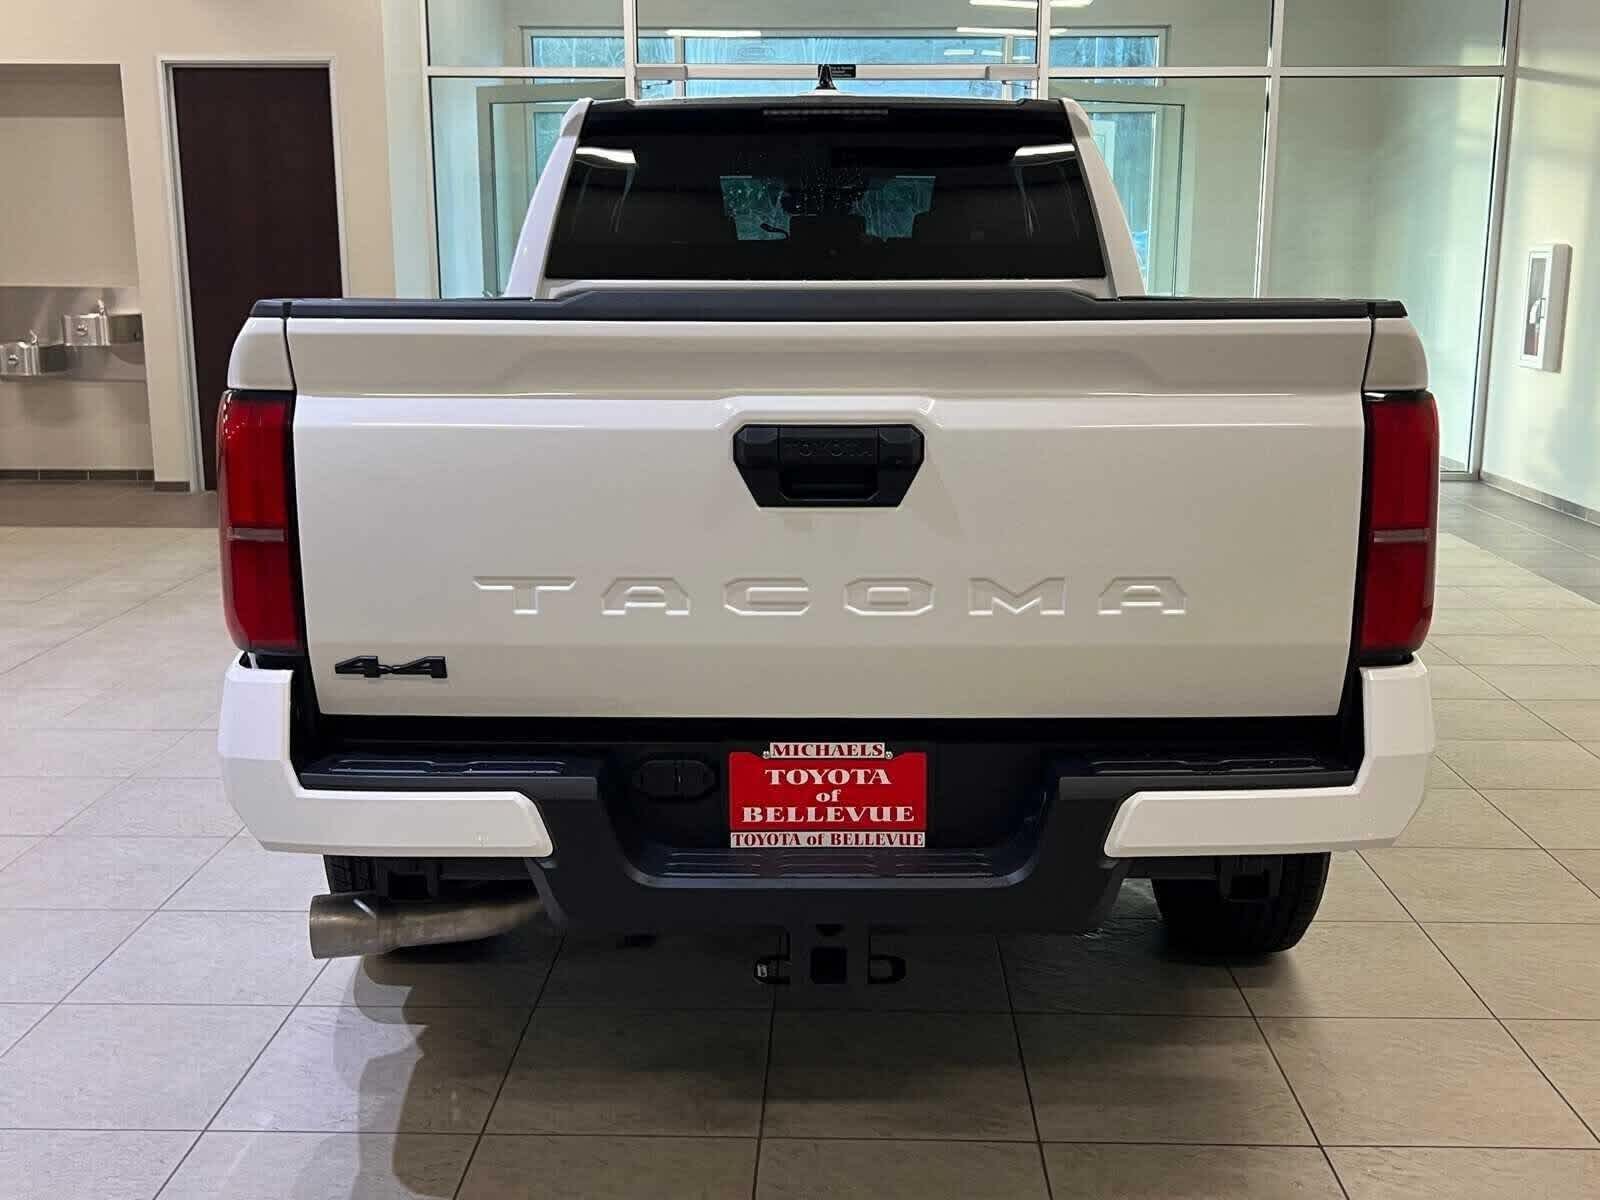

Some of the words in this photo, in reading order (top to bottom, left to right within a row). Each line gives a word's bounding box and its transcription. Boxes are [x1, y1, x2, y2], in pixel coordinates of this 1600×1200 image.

[473, 576, 1188, 616] TACOMA
[772, 743, 884, 757] MICHAELS
[765, 769, 892, 785] TOYOTA
[815, 789, 842, 803] of
[742, 806, 915, 823] BELLEVUE
[732, 833, 801, 846] TOYOTA
[806, 833, 825, 846] of
[830, 833, 924, 846] BELLEVUE
